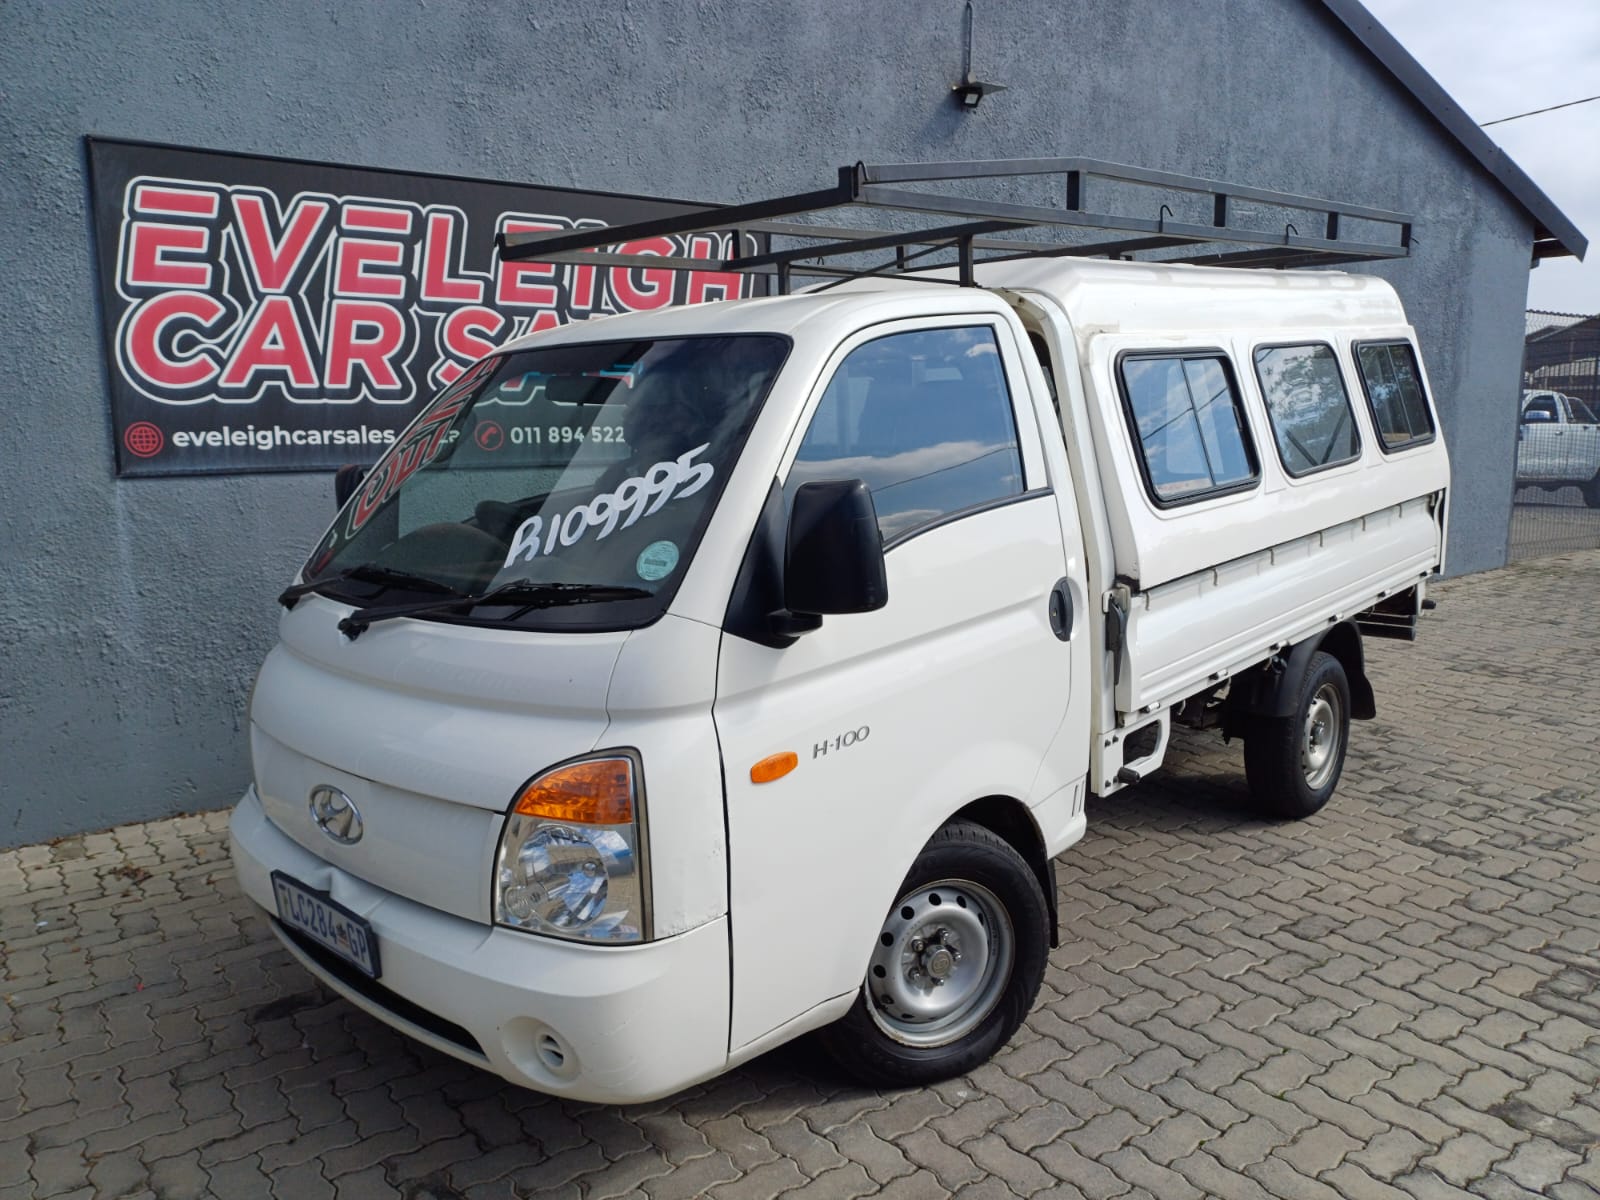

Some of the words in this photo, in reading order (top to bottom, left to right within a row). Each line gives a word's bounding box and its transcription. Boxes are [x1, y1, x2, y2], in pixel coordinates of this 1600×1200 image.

[122, 181, 748, 313] EVELEIGH
[122, 289, 409, 392] CAR
[510, 426, 541, 444] 011
[548, 426, 585, 443] 894
[591, 425, 626, 443] 522
[503, 442, 715, 569] R109995
[813, 725, 870, 759] H-100
